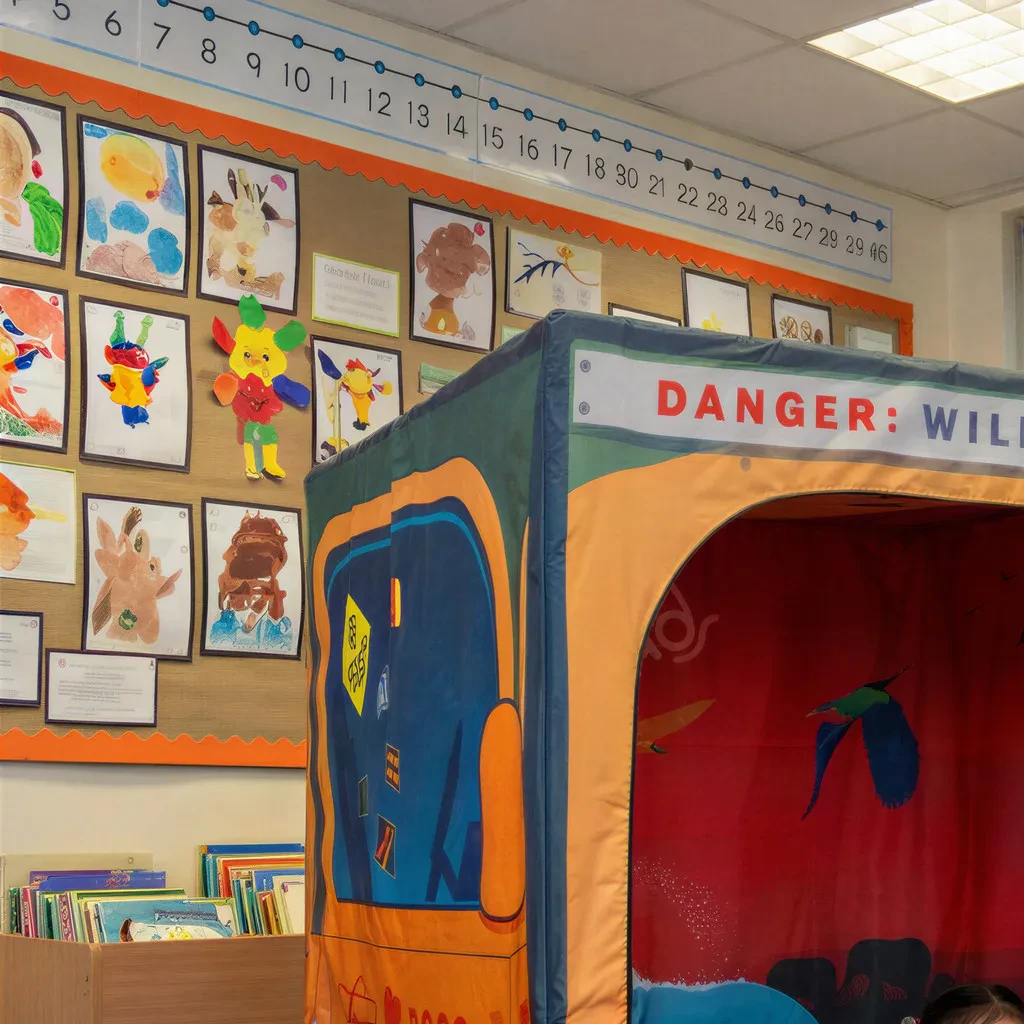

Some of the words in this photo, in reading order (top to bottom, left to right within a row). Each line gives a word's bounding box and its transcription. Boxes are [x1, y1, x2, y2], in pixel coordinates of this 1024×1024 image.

[53, 0, 71, 20] 5
[105, 10, 122, 36] 6
[154, 22, 171, 49] 7
[201, 38, 217, 64] 8
[247, 53, 261, 77] 9
[285, 63, 310, 92] 10
[330, 77, 347, 103] 11
[368, 88, 391, 116] 12
[408, 101, 430, 128] 13
[447, 113, 466, 138] 14
[483, 124, 504, 149] 15
[519, 135, 539, 160] 16
[553, 144, 572, 169] 17
[586, 154, 605, 179] 18
[616, 164, 638, 188] 30
[649, 174, 665, 197] 21
[678, 183, 698, 207] 22
[737, 201, 757, 225] 24
[765, 210, 784, 232] 26
[793, 218, 813, 240] 27
[819, 227, 838, 248] 29
[846, 235, 863, 256] 29
[657, 379, 897, 432] DANGER:
